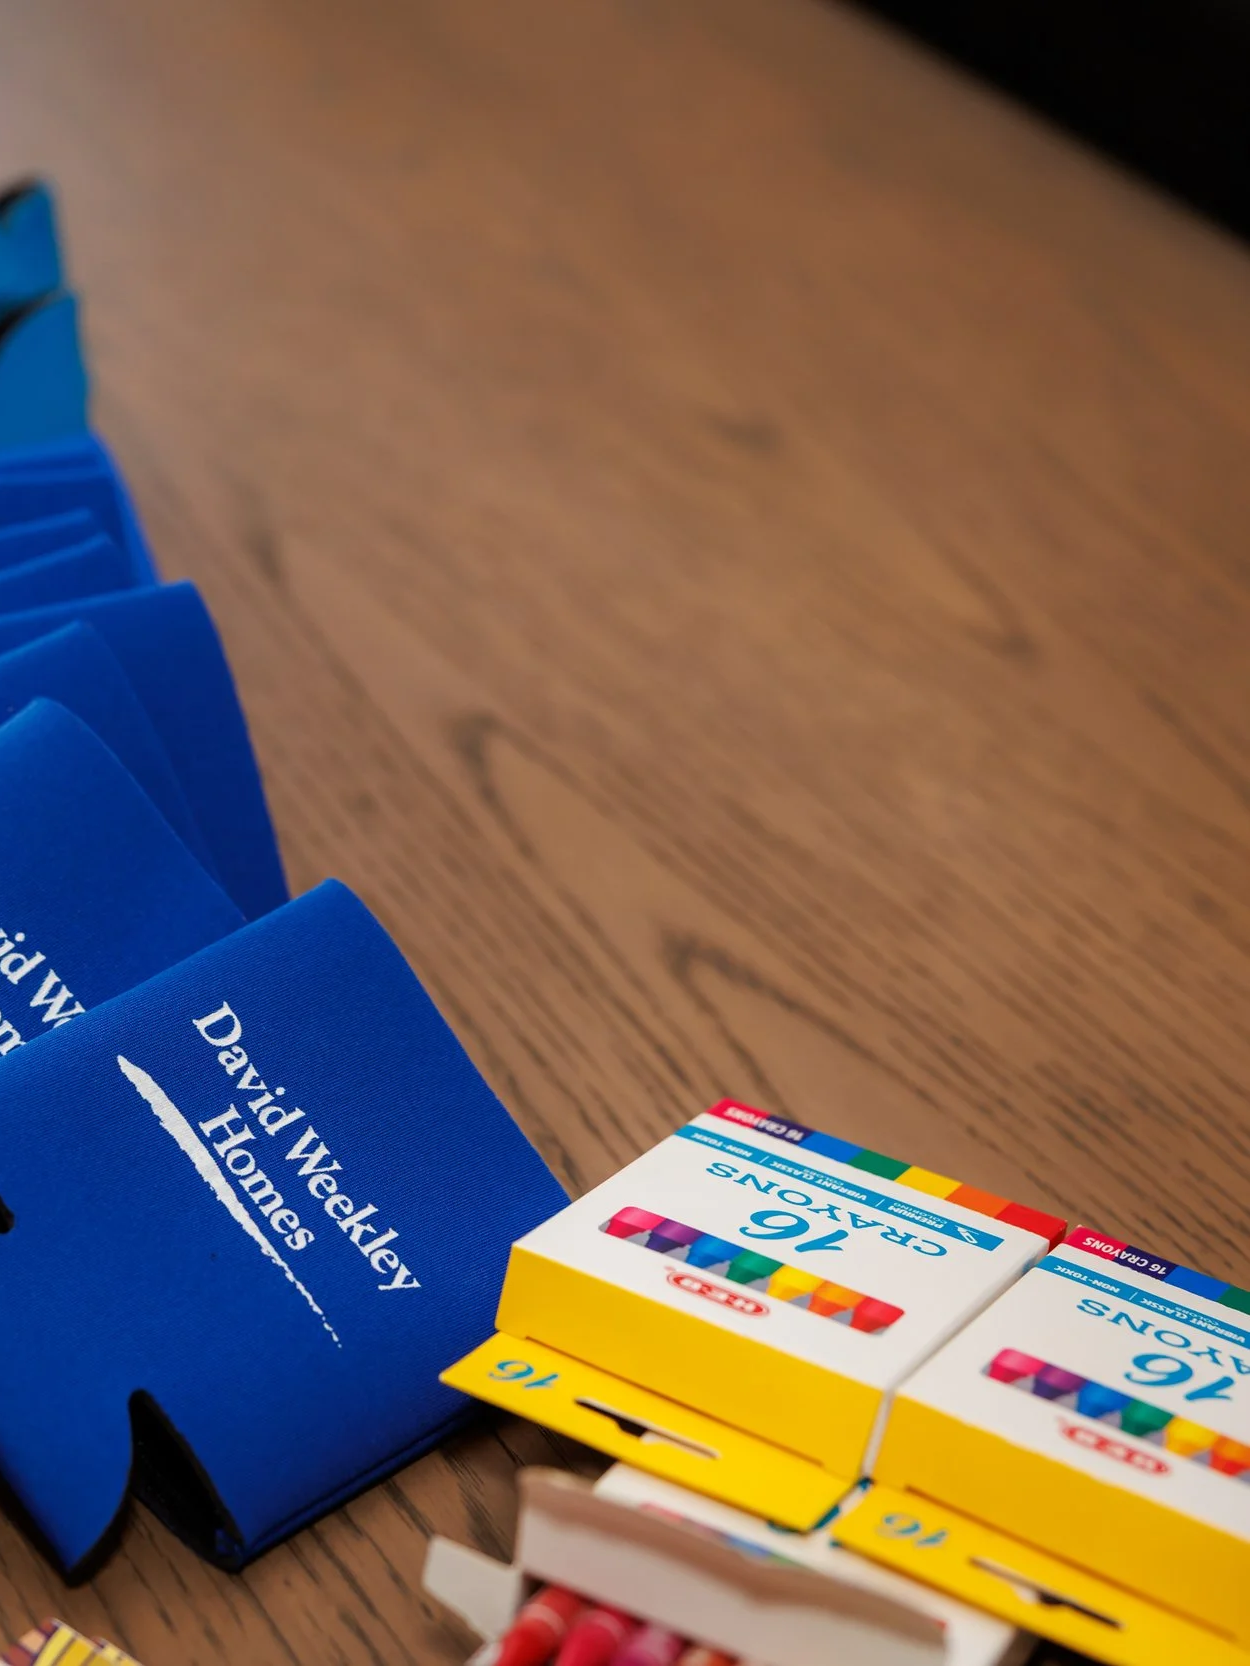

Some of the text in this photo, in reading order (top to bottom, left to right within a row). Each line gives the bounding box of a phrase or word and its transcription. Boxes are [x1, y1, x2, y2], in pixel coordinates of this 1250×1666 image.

[723, 1106, 805, 1142] 16 CRAYONS
[192, 1001, 422, 1291] David Weekley
[690, 1132, 753, 1158] NON-TOXIC
[198, 1103, 315, 1251] Homes
[770, 1160, 868, 1201] VIBRANT CLASSIC
[706, 1162, 948, 1257] CRAYONS
[888, 1205, 944, 1229] PREMIUM
[892, 1202, 948, 1225] COLORING
[739, 1209, 849, 1253] 16
[1082, 1237, 1168, 1276] 16 CRAYONS
[1053, 1265, 1121, 1294] NON-TOXIC
[1140, 1297, 1246, 1344] VIBRANT CLASSIC
[488, 1360, 559, 1389] 16
[1124, 1353, 1236, 1403] 16
[875, 1513, 948, 1548] 16
